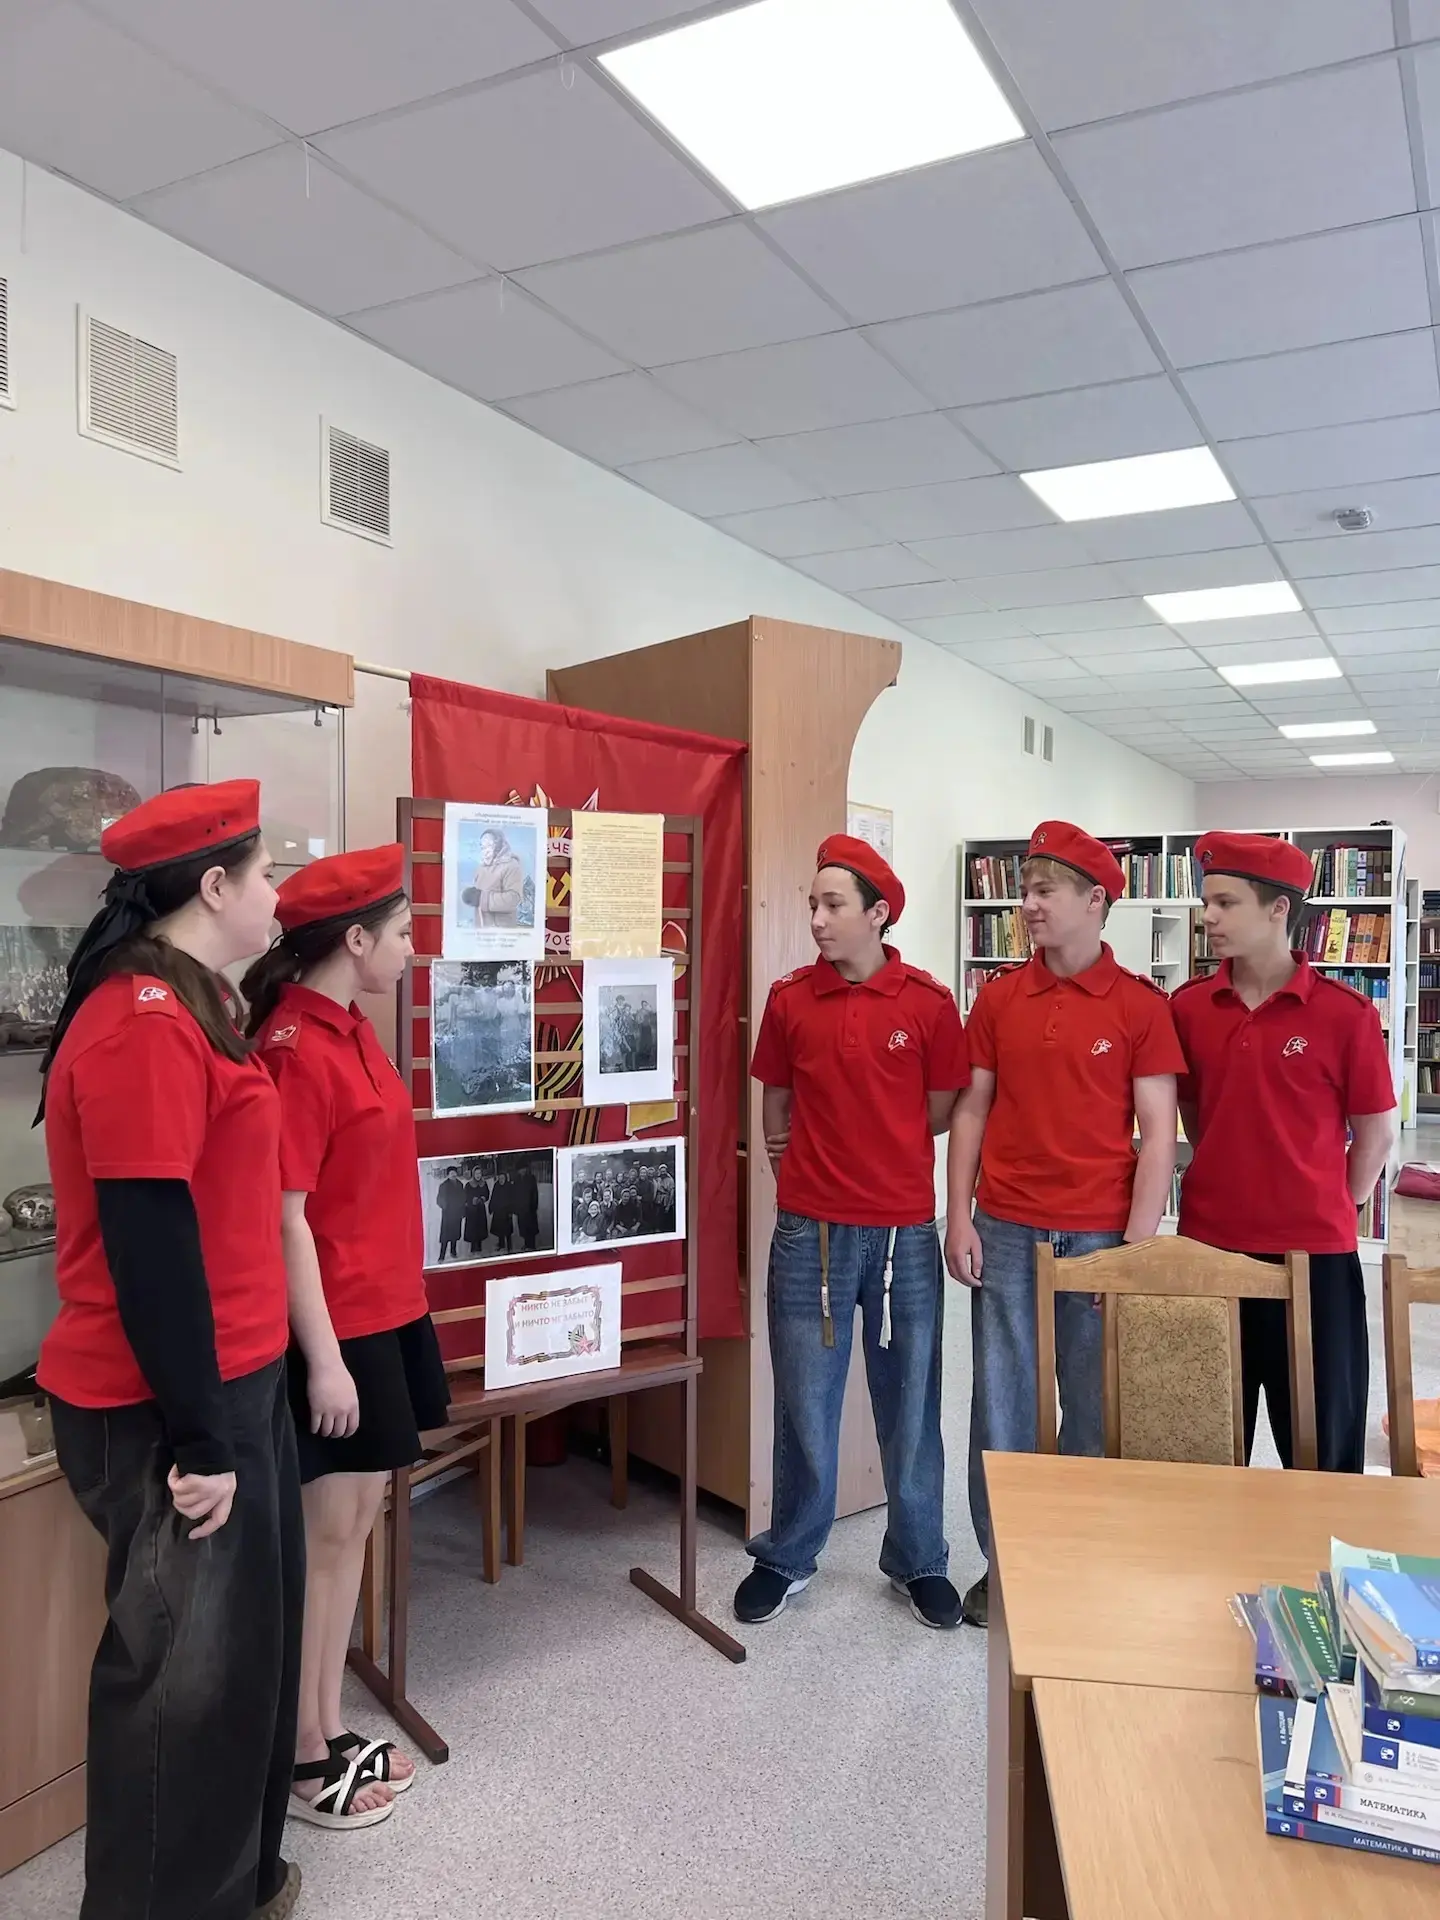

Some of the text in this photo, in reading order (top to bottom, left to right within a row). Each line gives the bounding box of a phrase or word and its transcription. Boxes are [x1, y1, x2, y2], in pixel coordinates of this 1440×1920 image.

[521, 1297, 587, 1312] НИКТО НЕ ЗАБЫТ
[522, 1318, 549, 1327] НИЧТО
[564, 1310, 594, 1319] ЗАБЫТО
[1360, 1798, 1427, 1820] МАТЕМАТИКА
[1353, 1837, 1409, 1853] МАТЕМАТИКА
